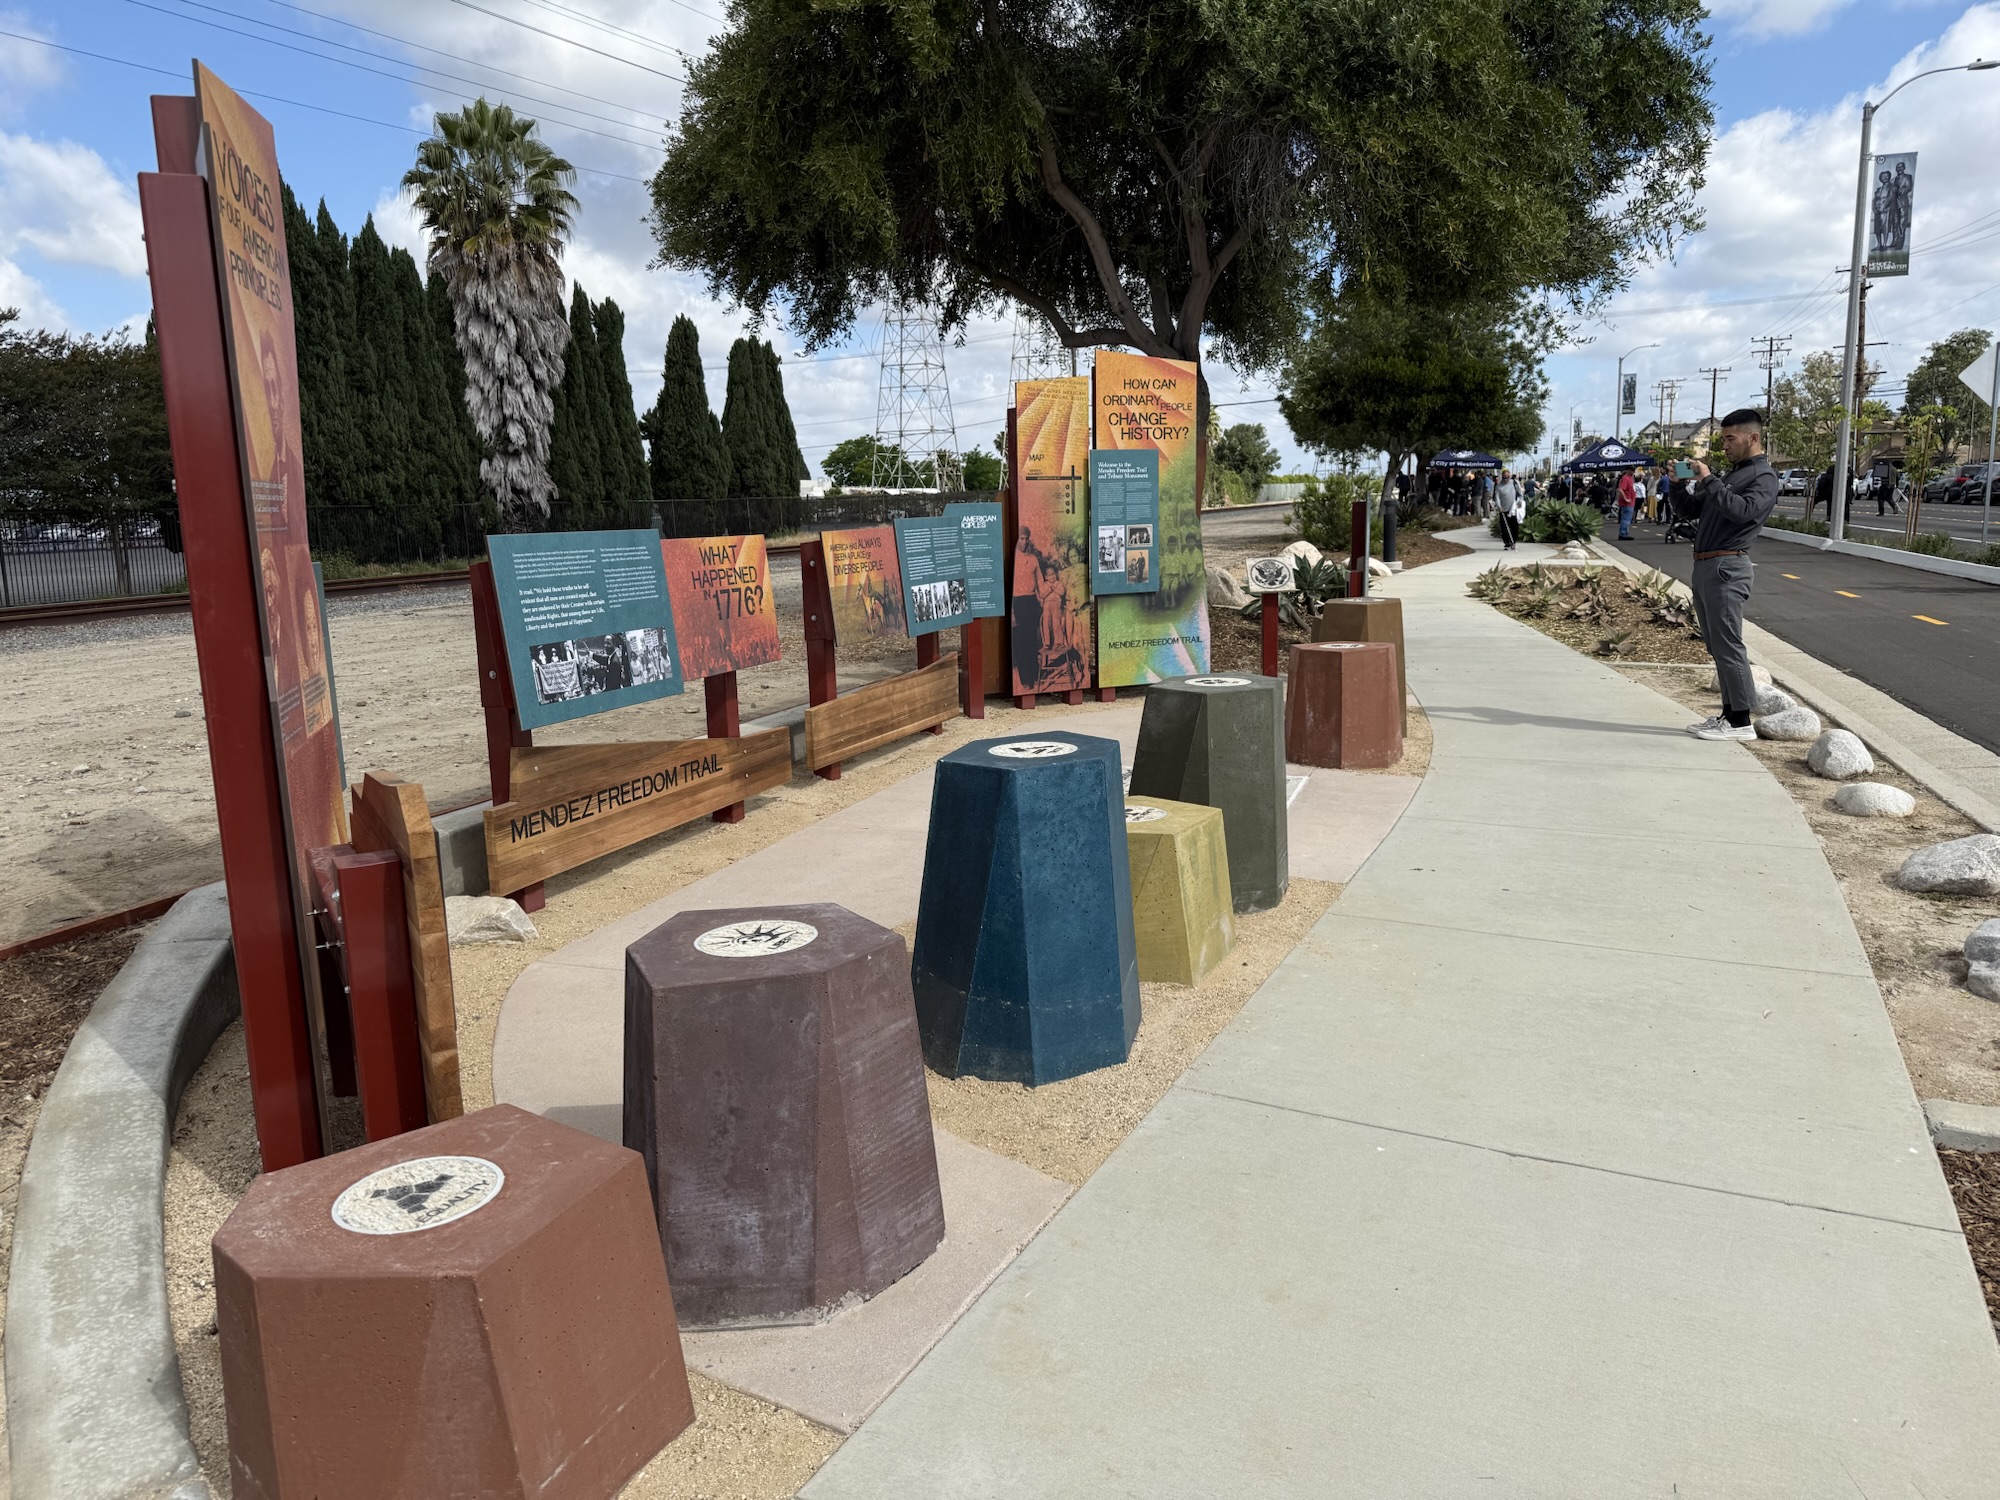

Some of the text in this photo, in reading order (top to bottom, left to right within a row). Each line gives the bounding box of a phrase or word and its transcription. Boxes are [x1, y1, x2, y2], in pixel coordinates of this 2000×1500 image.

[212, 130, 274, 234] VOICES
[226, 202, 242, 232] OUR
[243, 222, 285, 278] AMERICAN
[229, 250, 282, 312] PRINCIPLES
[1124, 379, 1176, 390] HOW CAN
[1103, 395, 1192, 411] ORDINARY PEOPLE
[1108, 412, 1167, 426] CHANGE
[1121, 426, 1189, 440] HISTORY?
[830, 544, 848, 552] AMERICA
[858, 537, 881, 549] ALWAYS
[699, 545, 737, 566] WHAT
[834, 553, 846, 561] BEEN
[850, 551, 865, 560] PLACE
[834, 560, 884, 576] DIVERSE PEOPLE
[691, 566, 757, 589] HAPPENED
[703, 585, 763, 620] IN 1776?
[1108, 640, 1141, 649] MENDEZ
[1142, 637, 1179, 646] FREEDOM
[510, 753, 723, 844] MENDEZ FREEDOM TRAIL
[415, 1179, 490, 1223] EQUALITY
